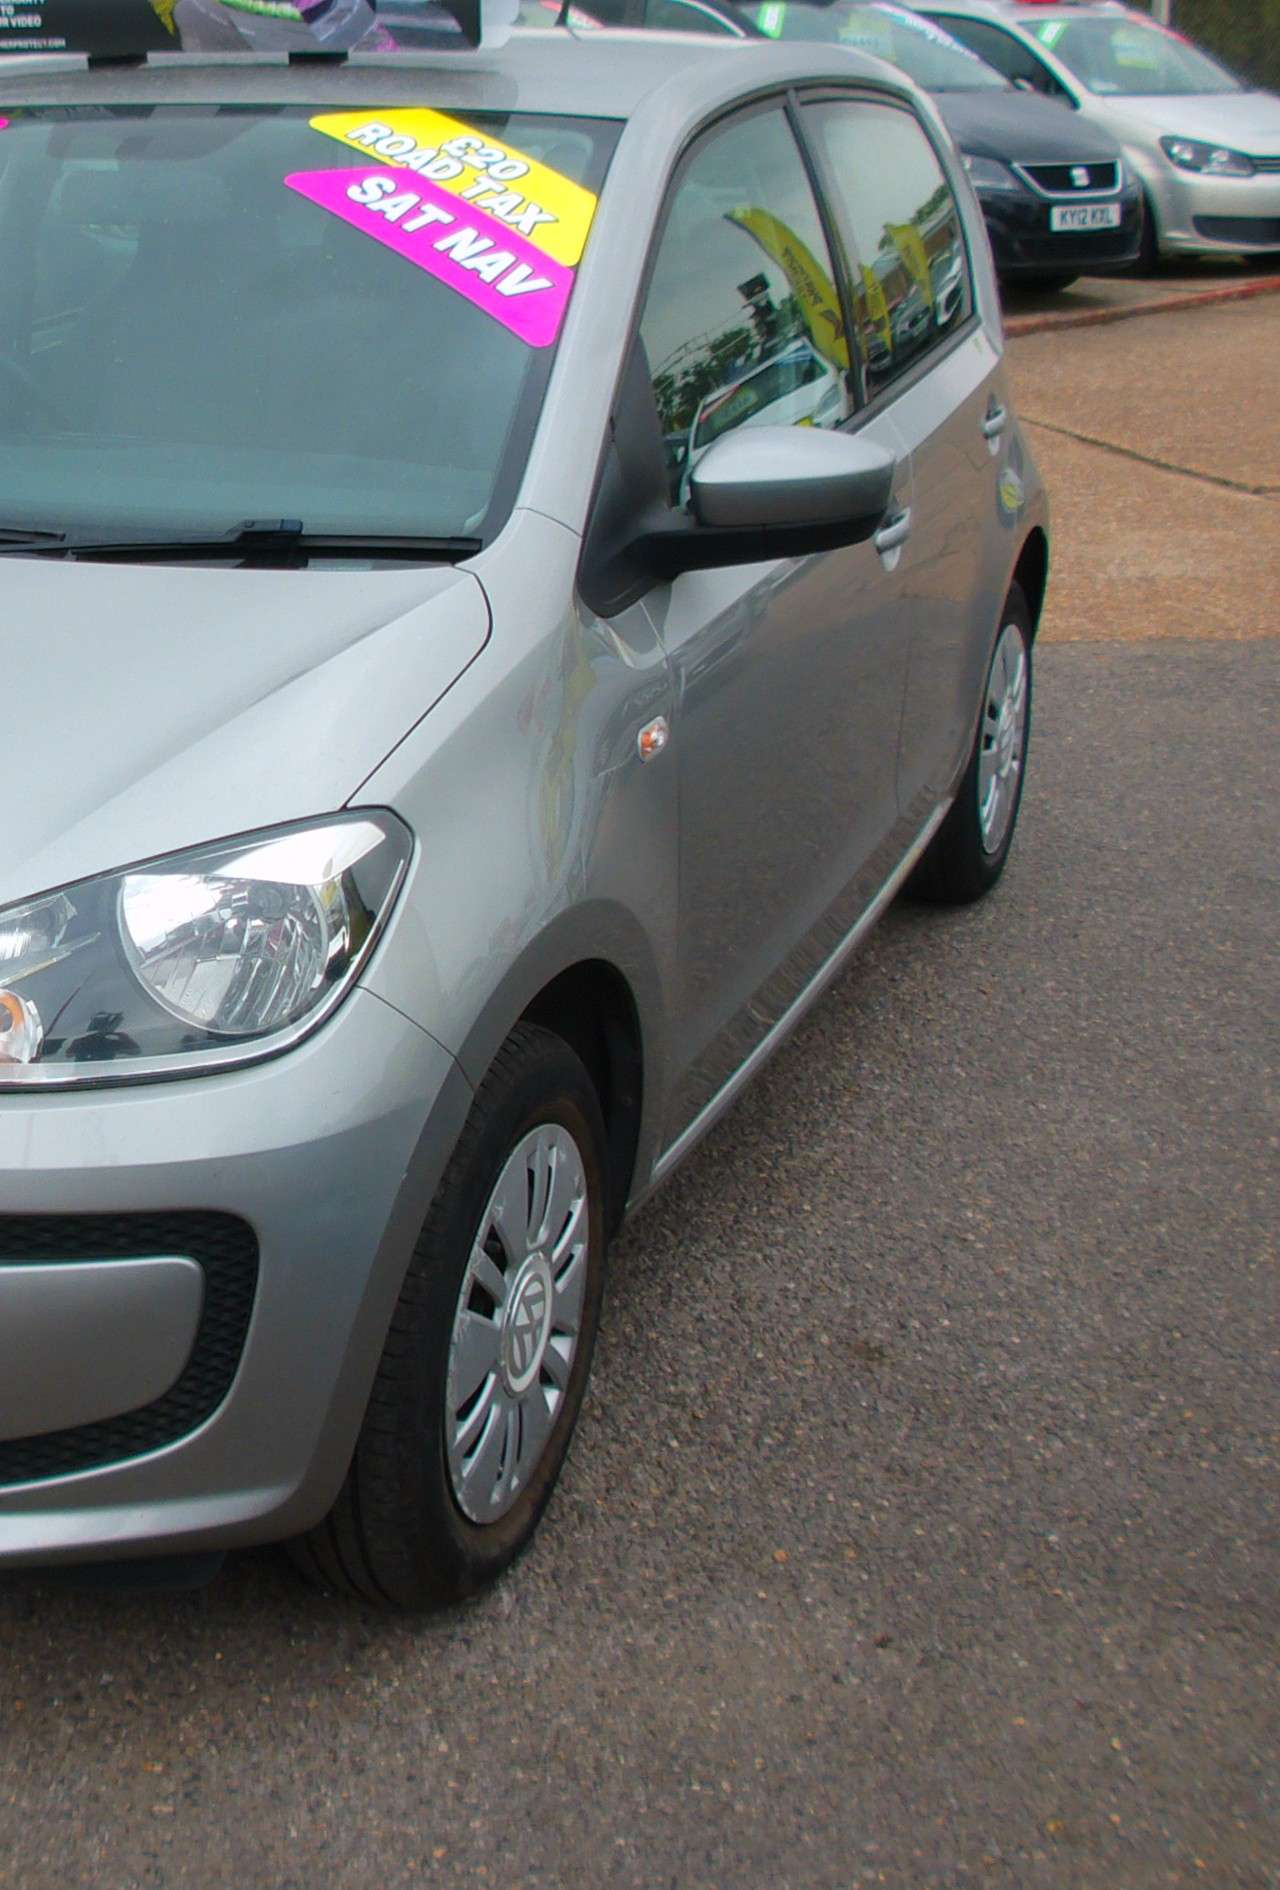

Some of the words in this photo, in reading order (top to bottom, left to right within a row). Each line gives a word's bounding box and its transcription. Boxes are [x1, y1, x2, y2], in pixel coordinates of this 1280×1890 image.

[0, 5, 14, 15] TO
[11, 15, 42, 28] VIDEO
[346, 122, 465, 181] ROAD
[460, 175, 559, 236] TAX
[442, 136, 529, 181] £20
[346, 176, 456, 233] SAT
[432, 227, 556, 296] NAV
